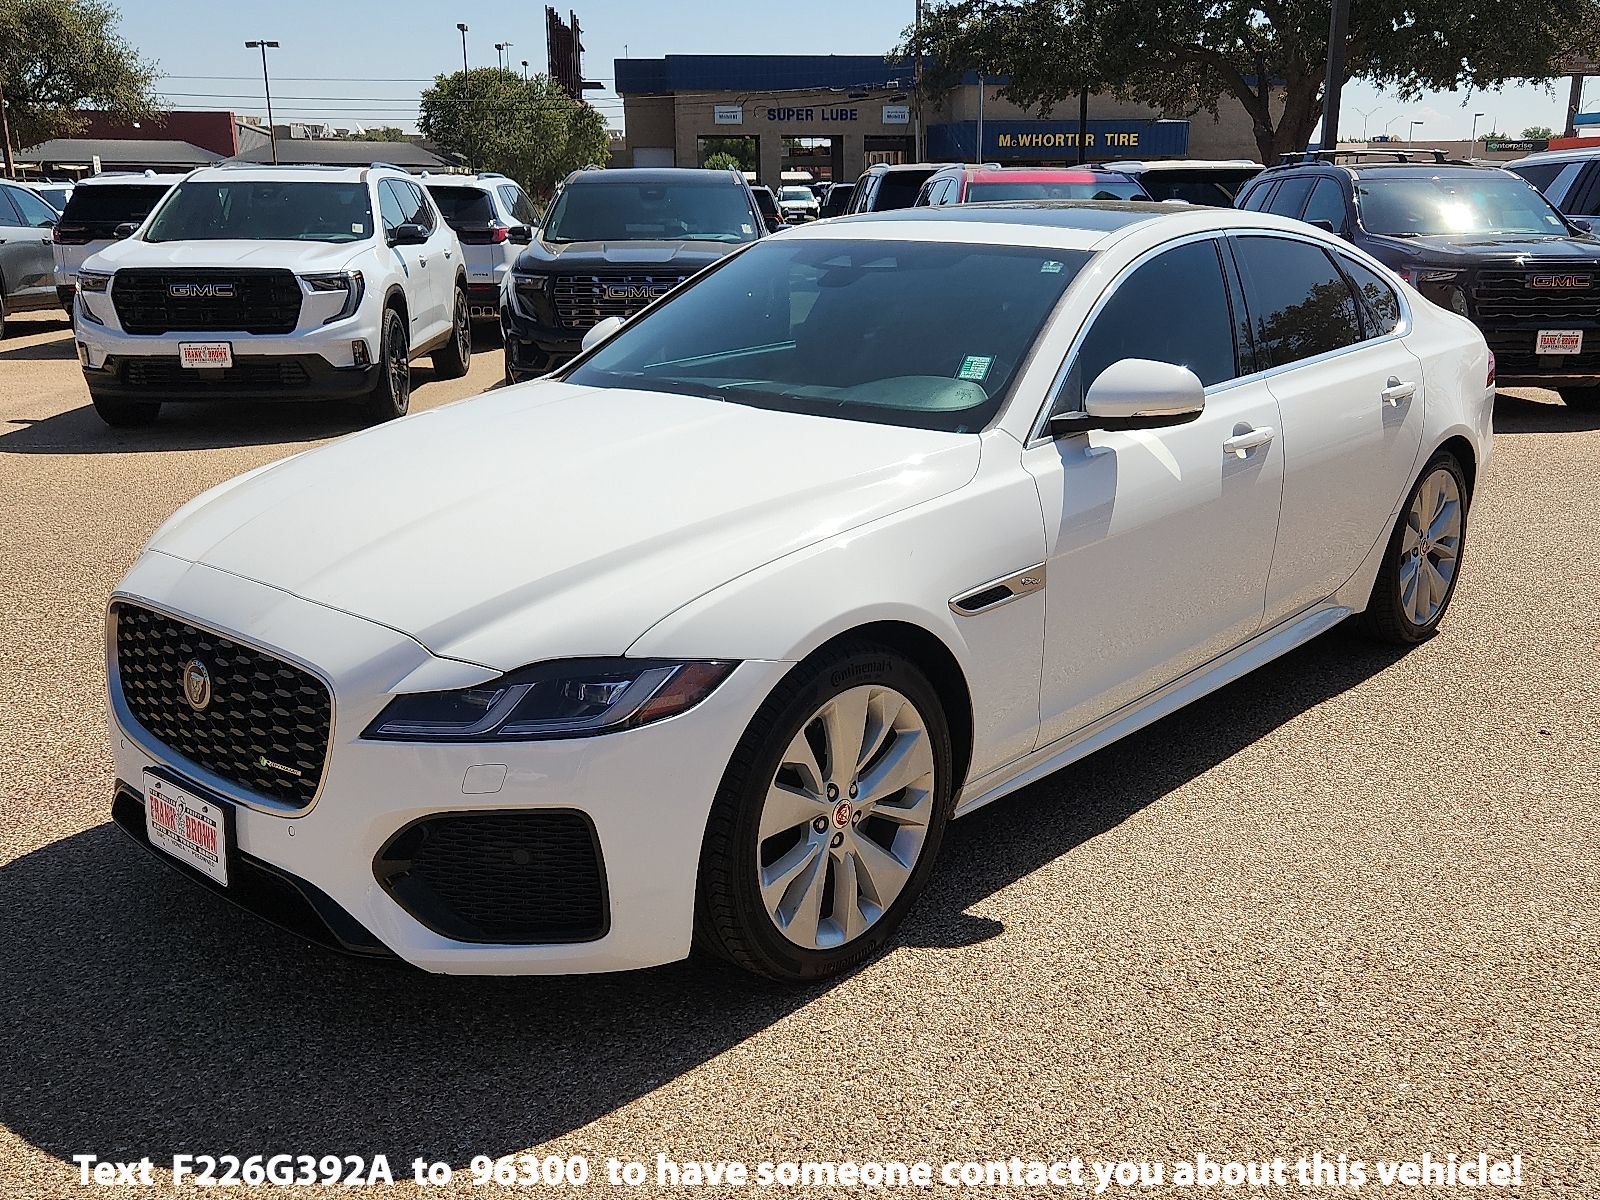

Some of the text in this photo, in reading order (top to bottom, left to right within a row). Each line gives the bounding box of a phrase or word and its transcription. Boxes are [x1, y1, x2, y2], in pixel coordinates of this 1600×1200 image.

[767, 108, 858, 121] SUPER LUBE
[1104, 133, 1139, 147] TIRE
[1488, 142, 1533, 150] enterprise
[1533, 275, 1591, 287] GMC
[169, 283, 234, 297] GMC
[608, 285, 669, 298] GMC
[149, 795, 218, 855] FRANK BROWN
